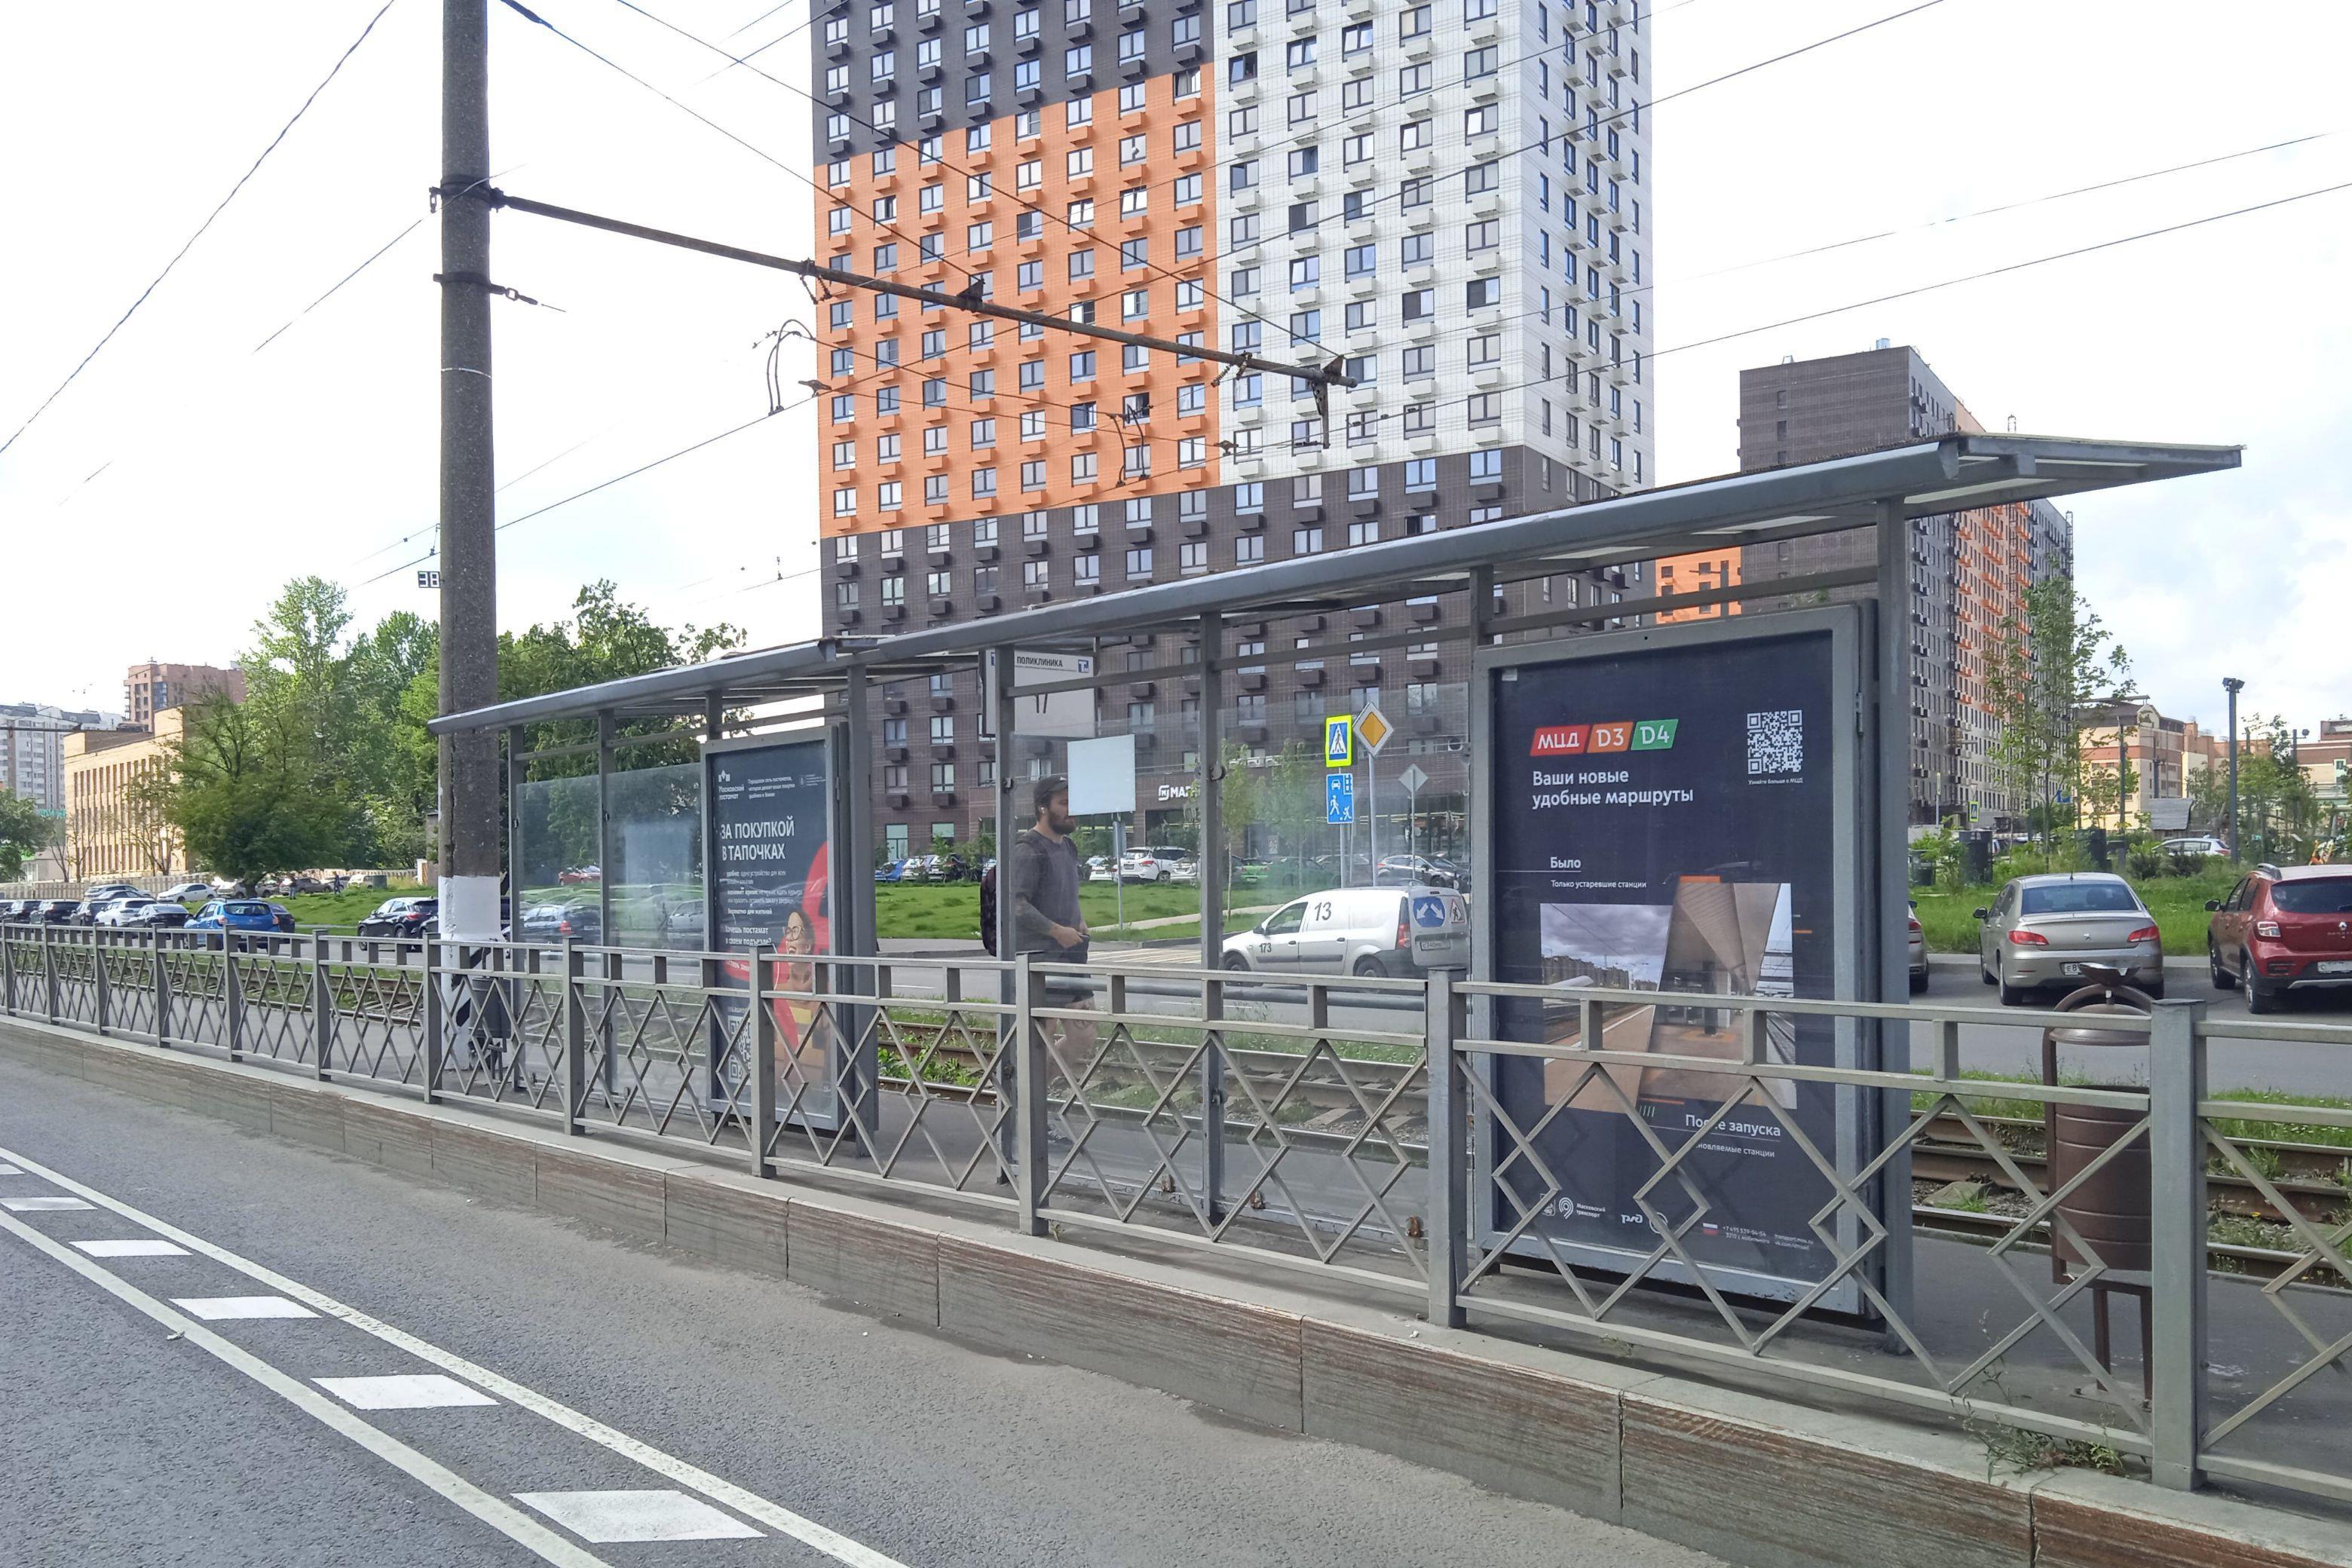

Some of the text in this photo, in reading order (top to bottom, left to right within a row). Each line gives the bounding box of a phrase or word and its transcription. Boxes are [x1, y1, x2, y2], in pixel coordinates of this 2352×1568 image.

[418, 571, 440, 588] 38
[1017, 657, 1063, 667] ПОЛИКЛИНИКА
[1538, 732, 1580, 749] МЦД
[1596, 724, 1670, 747] D3 D4
[1533, 770, 1629, 786] Ваши новые
[1532, 789, 1693, 810] удобные маршруты
[721, 815, 795, 839] ЗА ПОКУПКОЙ
[722, 844, 786, 861] В ТАПОЧКАХ
[1550, 856, 1582, 868] Было
[1575, 880, 1616, 889] устаревшие
[1314, 902, 1332, 921] 13
[1259, 942, 1272, 953] 173
[1729, 1122, 1781, 1137] запуска
[1743, 1148, 1775, 1157] станции
[1576, 1202, 1606, 1212] Московский
[1576, 1209, 1600, 1218] транспорт
